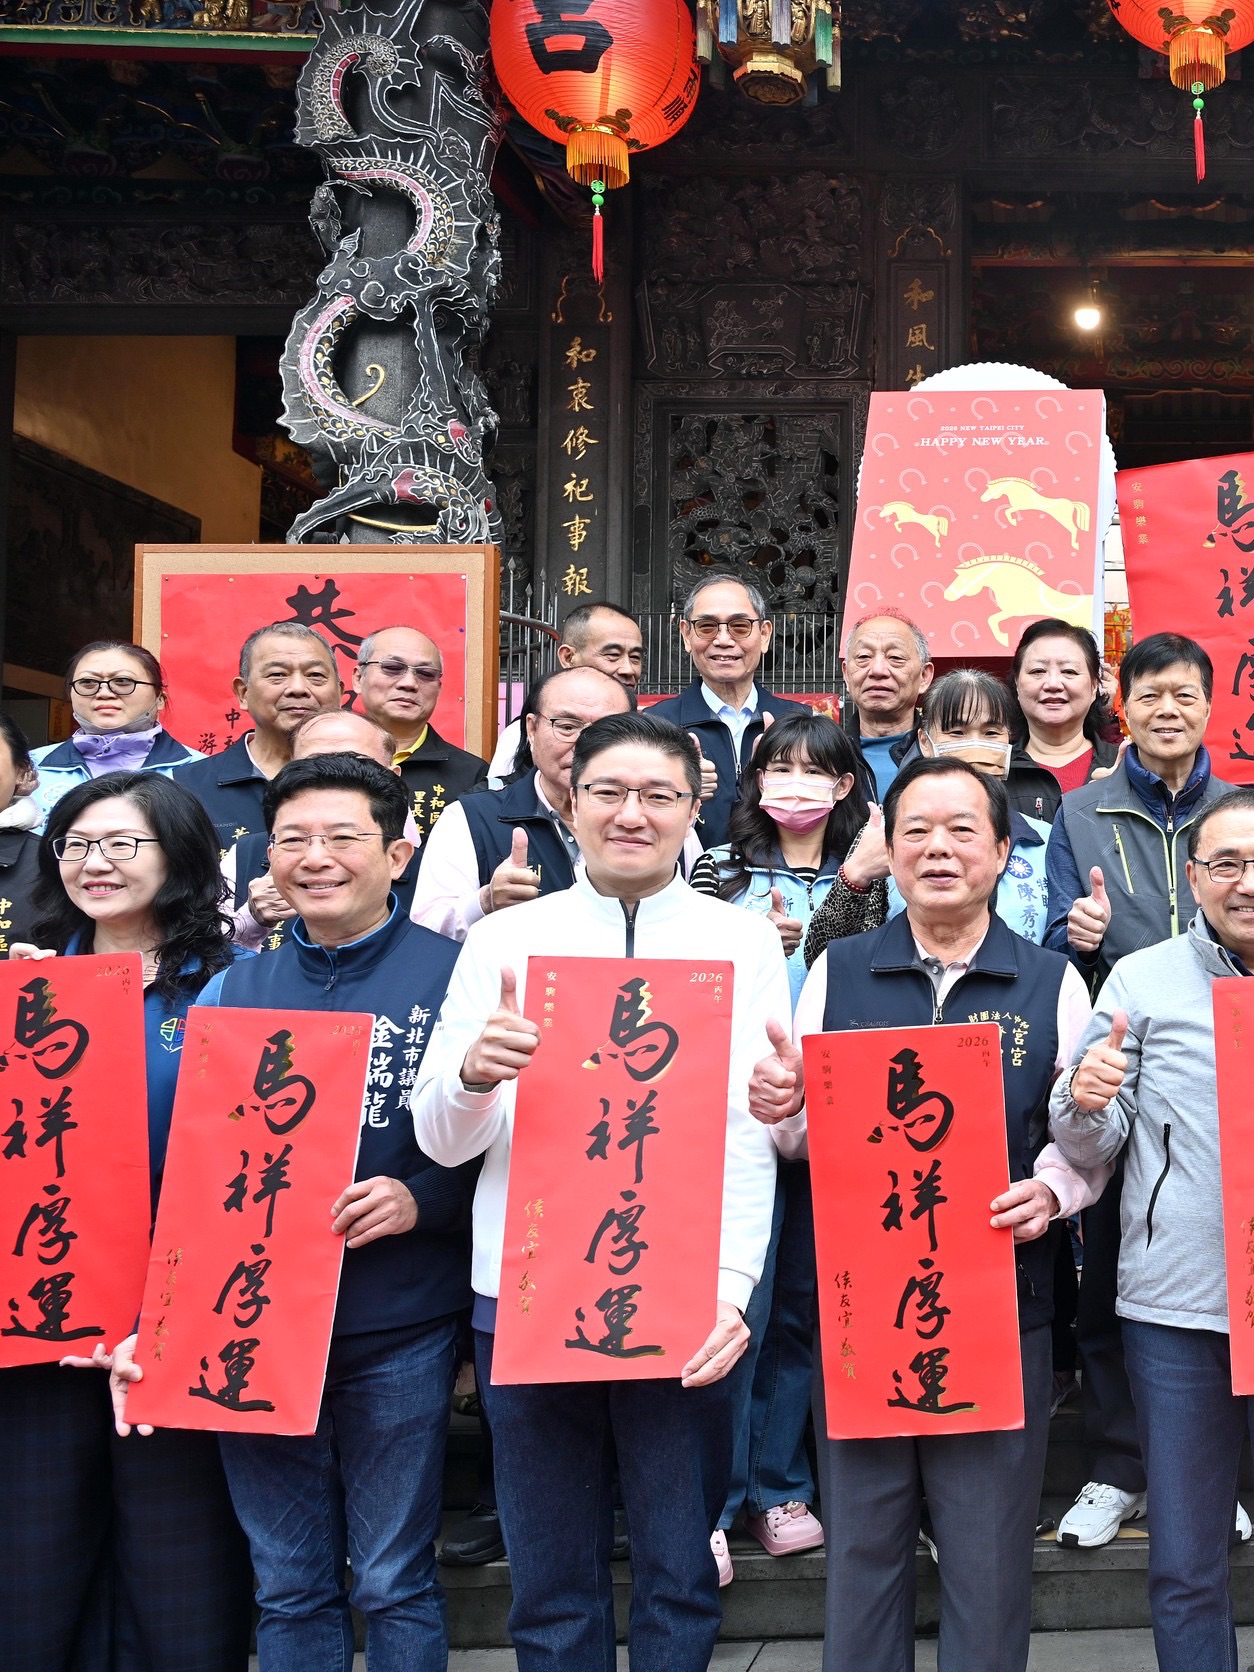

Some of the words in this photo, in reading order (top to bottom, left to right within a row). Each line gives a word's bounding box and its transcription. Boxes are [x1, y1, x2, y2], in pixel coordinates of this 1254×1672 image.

[920, 437, 967, 447] HAPPY
[972, 436, 1002, 447] NEW
[1008, 436, 1046, 446] YEAR
[395, 1004, 431, 1111] 新北市議員
[689, 972, 724, 984] 2026
[957, 1036, 989, 1048] 2026
[0, 977, 106, 1338] 馬祥厚運
[188, 1029, 317, 1413] 馬祥厚運
[564, 976, 680, 1359] 馬祥厚運
[867, 1047, 979, 1414] 馬祥厚運
